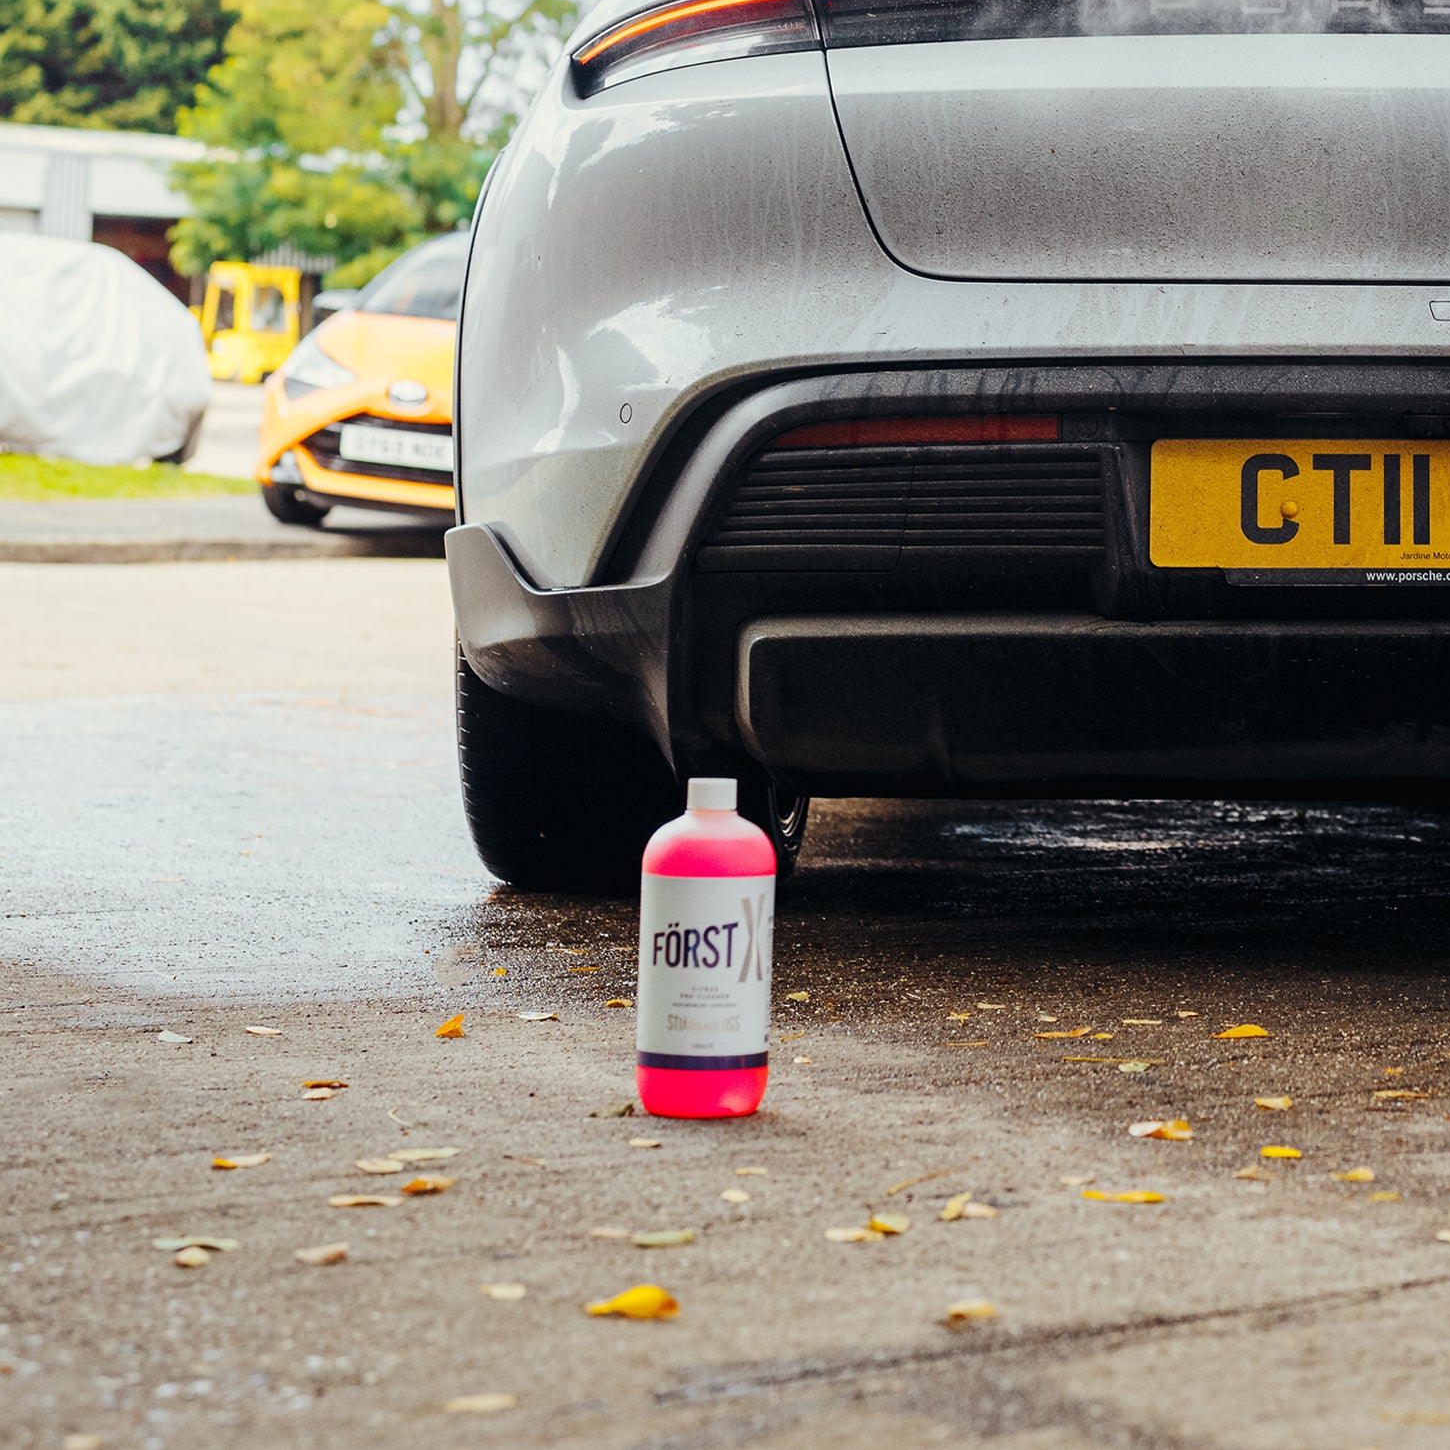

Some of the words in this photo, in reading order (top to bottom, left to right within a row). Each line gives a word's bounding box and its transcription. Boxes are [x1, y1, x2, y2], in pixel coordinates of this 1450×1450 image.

[1400, 552, 1431, 561] Jardine
[652, 921, 739, 969] FÖRST
[738, 893, 766, 983] X
